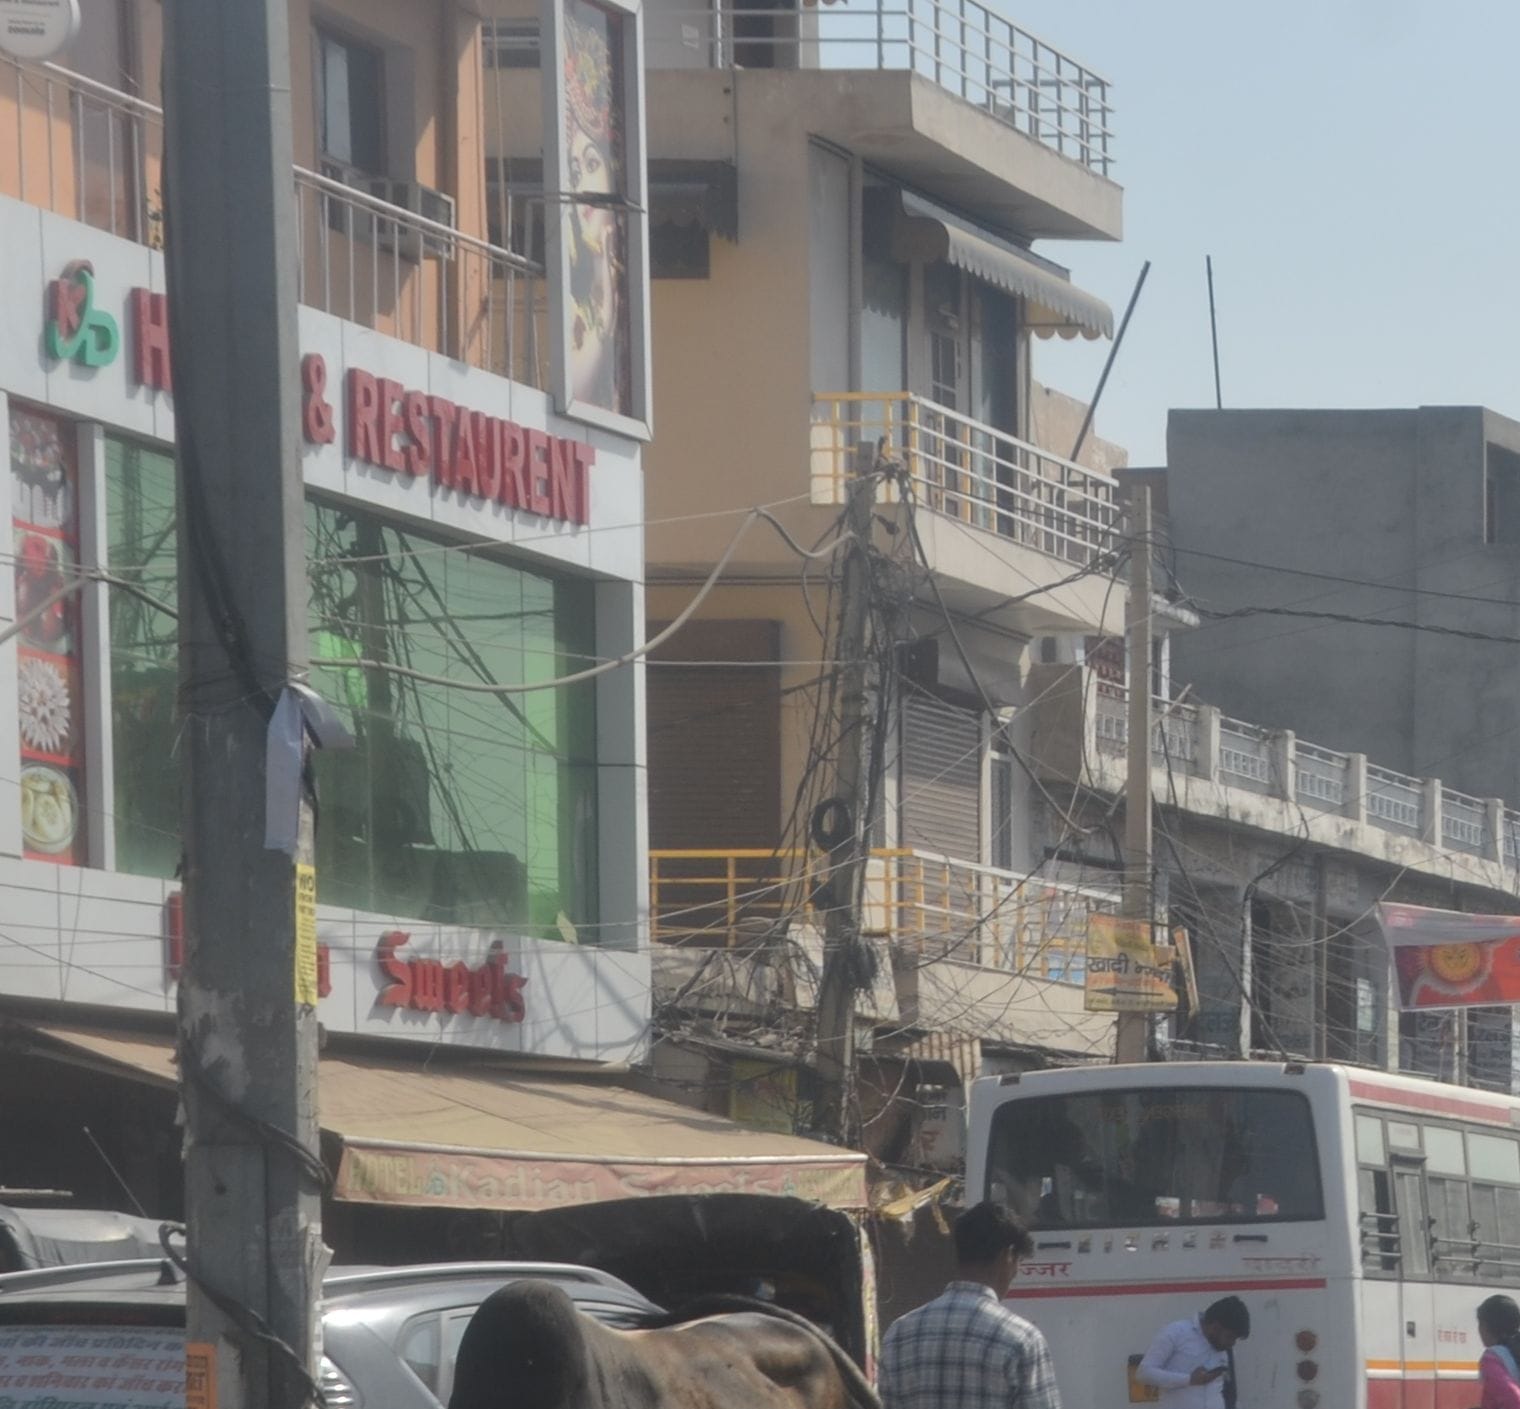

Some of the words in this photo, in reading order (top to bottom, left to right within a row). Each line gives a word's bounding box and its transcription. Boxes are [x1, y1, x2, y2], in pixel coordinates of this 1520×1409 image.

[301, 352, 334, 444] &
[348, 367, 597, 525] RESTAURENT
[376, 930, 530, 1024] Sweets
[1088, 952, 1129, 974] खादी
[347, 1153, 423, 1197] HOTEL
[443, 1162, 598, 1202] Kadian
[1018, 1262, 1073, 1277] ज्जर
